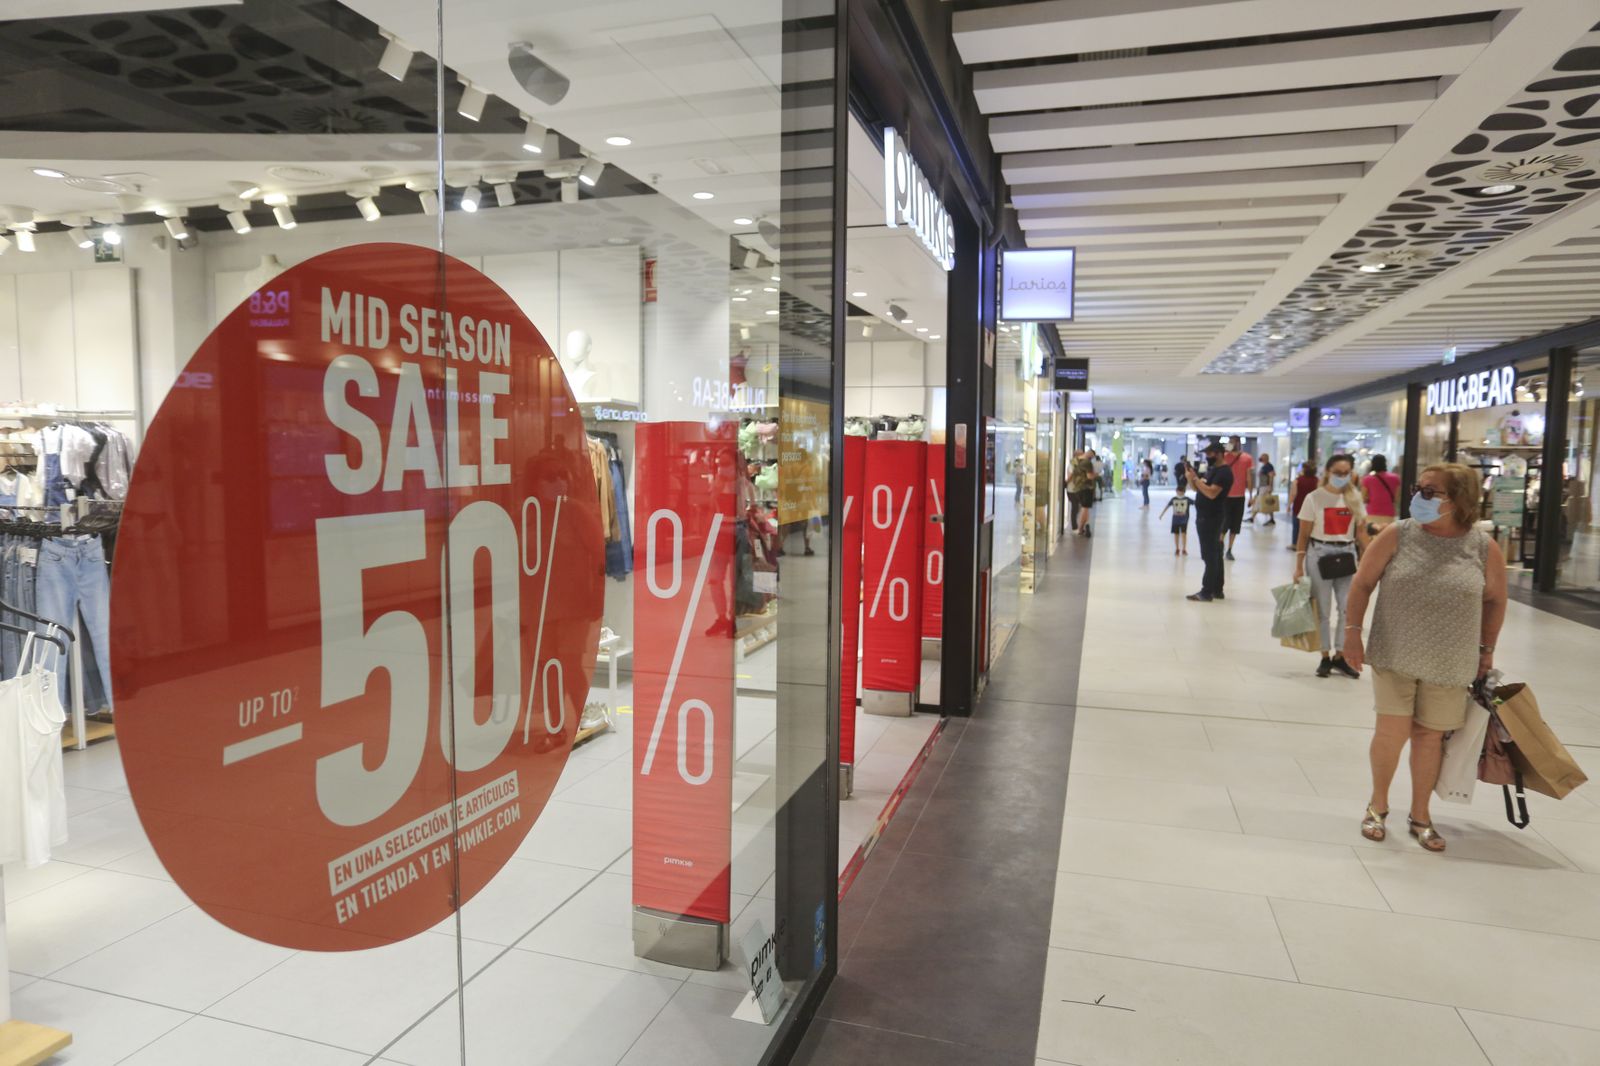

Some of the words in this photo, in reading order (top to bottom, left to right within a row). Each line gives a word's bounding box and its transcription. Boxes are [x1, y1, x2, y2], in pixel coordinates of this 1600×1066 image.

[1007, 275, 1068, 291] Larios
[321, 286, 390, 349] MID
[400, 303, 511, 367] SEASON
[323, 354, 511, 495] SALE
[1426, 366, 1517, 415] PULL&BEAR
[239, 696, 264, 727] UP
[334, 861, 353, 885] EN
[355, 847, 385, 874] UNA
[385, 812, 449, 857] SELECCIÓN
[466, 778, 516, 818] ARTÍCULOS
[335, 893, 359, 924] EN
[361, 862, 420, 908] TIENDA
[419, 854, 430, 875] Y
[432, 843, 451, 869] EN
